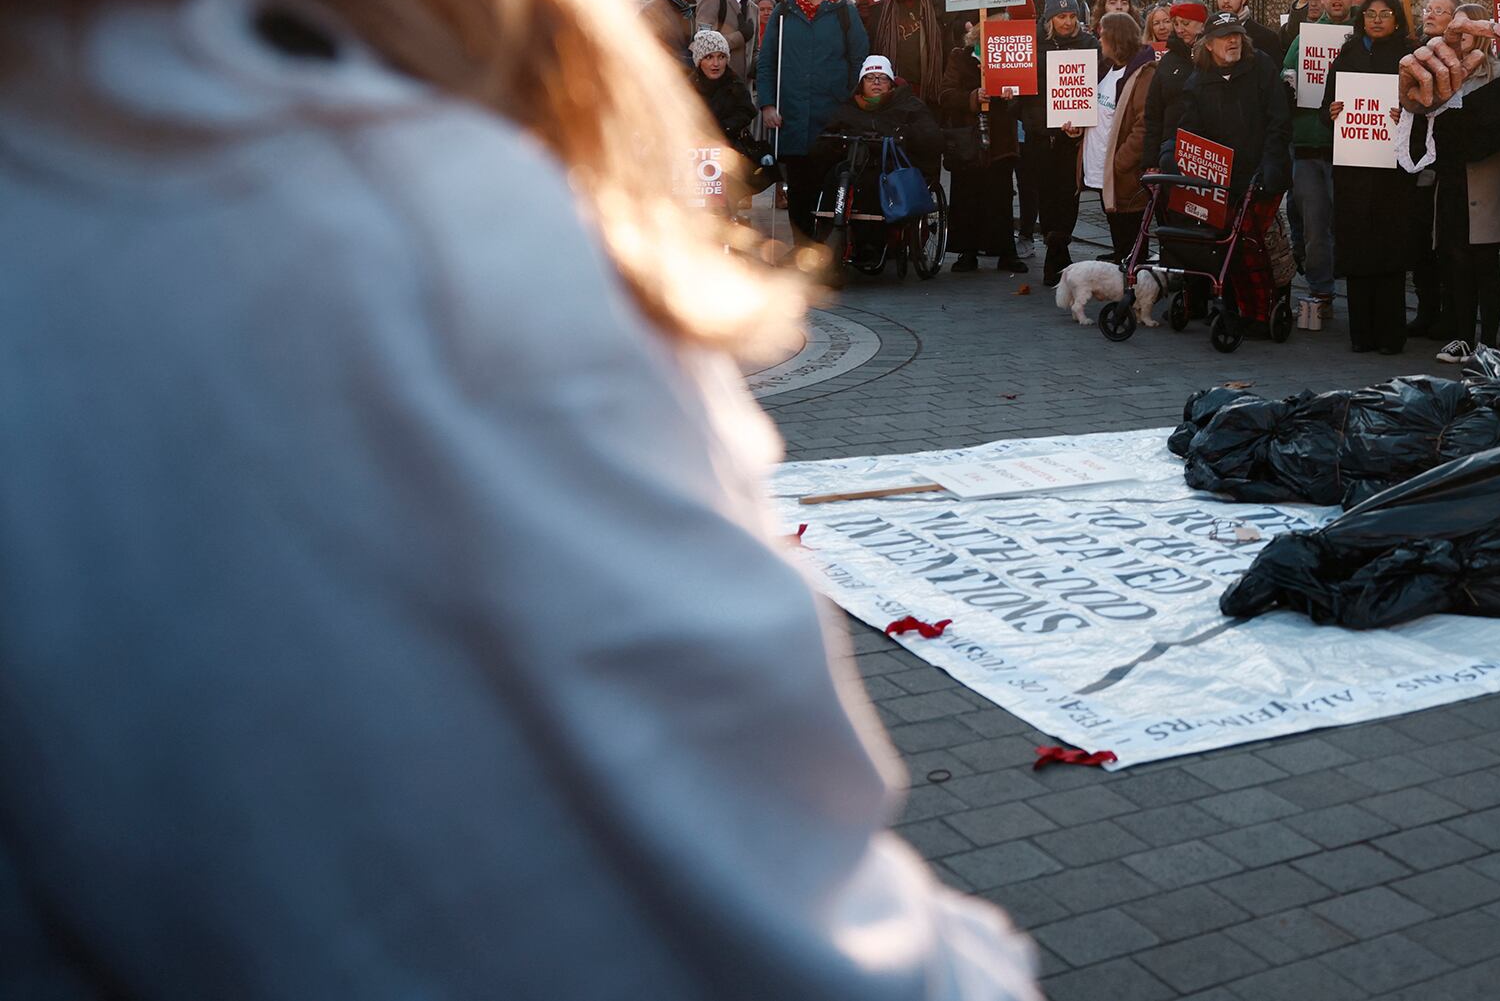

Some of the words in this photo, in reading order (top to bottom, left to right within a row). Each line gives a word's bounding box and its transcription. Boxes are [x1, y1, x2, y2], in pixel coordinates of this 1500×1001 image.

[988, 35, 1032, 44] ASSISTED
[988, 43, 1032, 52] SUICIDE
[1306, 46, 1325, 58] KILL
[989, 52, 1002, 62] IS
[1006, 51, 1032, 62] NOT
[1059, 64, 1085, 74] DON'T
[1304, 60, 1325, 72] BILL,
[1059, 76, 1085, 86] MAKE
[1307, 73, 1324, 84] THE
[1052, 88, 1093, 98] DOCTORS
[1053, 99, 1091, 110] KILLERS.
[1354, 99, 1365, 110] IF
[1368, 99, 1379, 111] IN
[1346, 113, 1386, 128] DOUBT,
[1341, 127, 1369, 140] VOTE
[1372, 129, 1390, 141] NO.
[1180, 140, 1201, 156] THE
[1204, 150, 1228, 167] BILL
[1178, 150, 1228, 174] SAFEGUARDS
[1177, 158, 1228, 185] ARENT
[826, 516, 1090, 634] INTENTIONS
